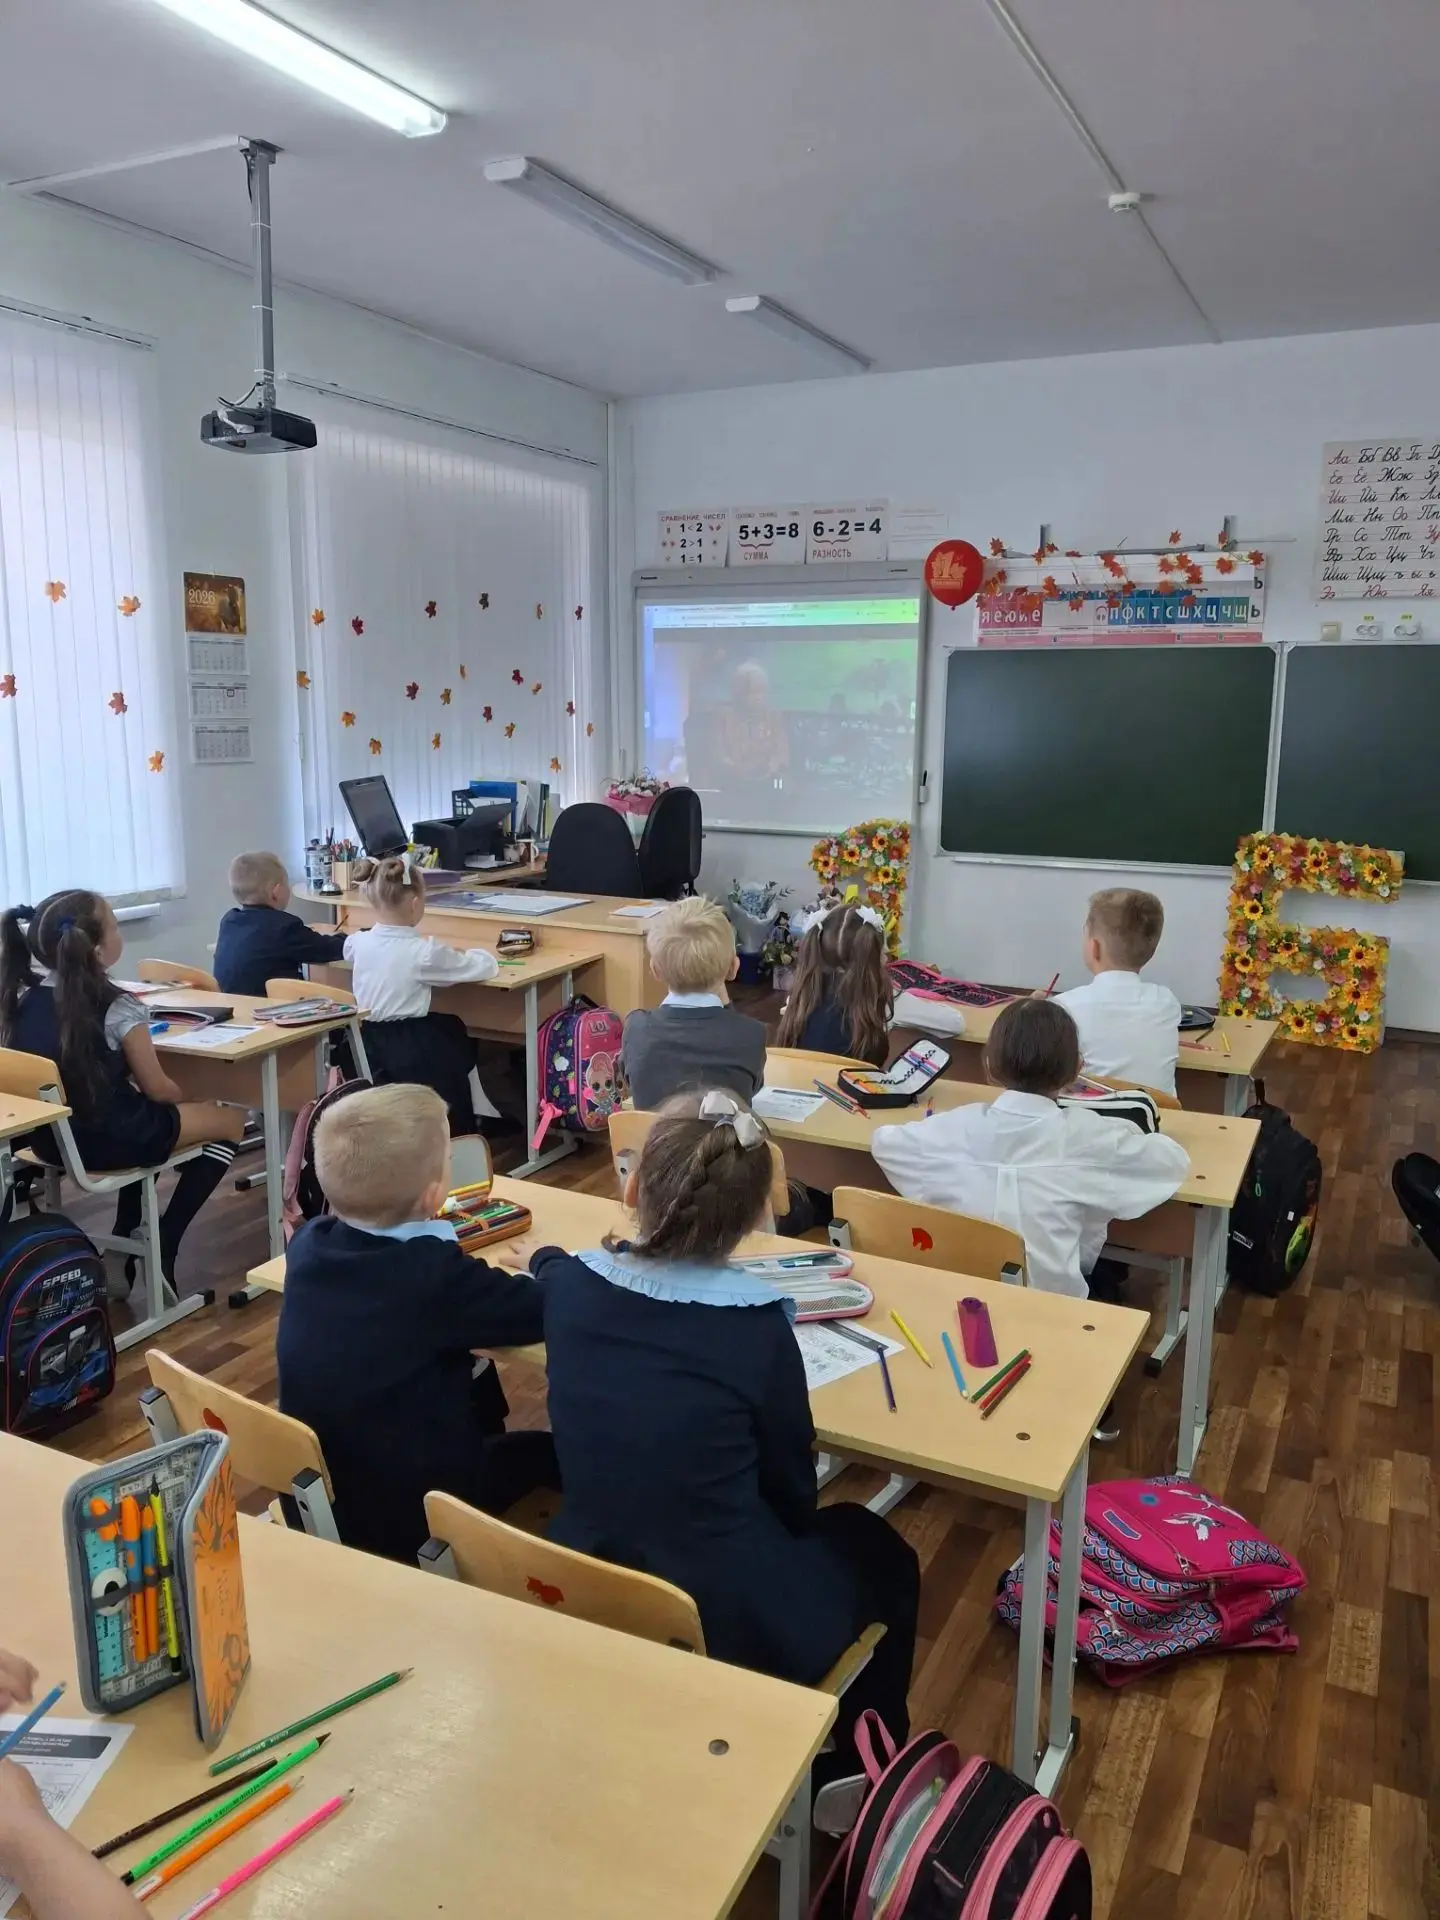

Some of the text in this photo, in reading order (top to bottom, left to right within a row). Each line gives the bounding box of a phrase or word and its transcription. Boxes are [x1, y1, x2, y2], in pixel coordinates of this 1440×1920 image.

[1358, 446, 1382, 463] Бб
[1382, 446, 1401, 463] Вв
[1377, 466, 1413, 482] Жж
[1353, 527, 1368, 542] Сс
[1380, 525, 1411, 541] Тт
[743, 551, 769, 560] СУММА
[812, 548, 852, 559] РАЗНОСТЬ
[1351, 546, 1377, 561] Хх
[1386, 545, 1408, 563] Цц
[1322, 566, 1349, 581] Шш
[1356, 566, 1387, 583] Щщ
[188, 588, 216, 604] 2026
[42, 1268, 81, 1289] SPEED
